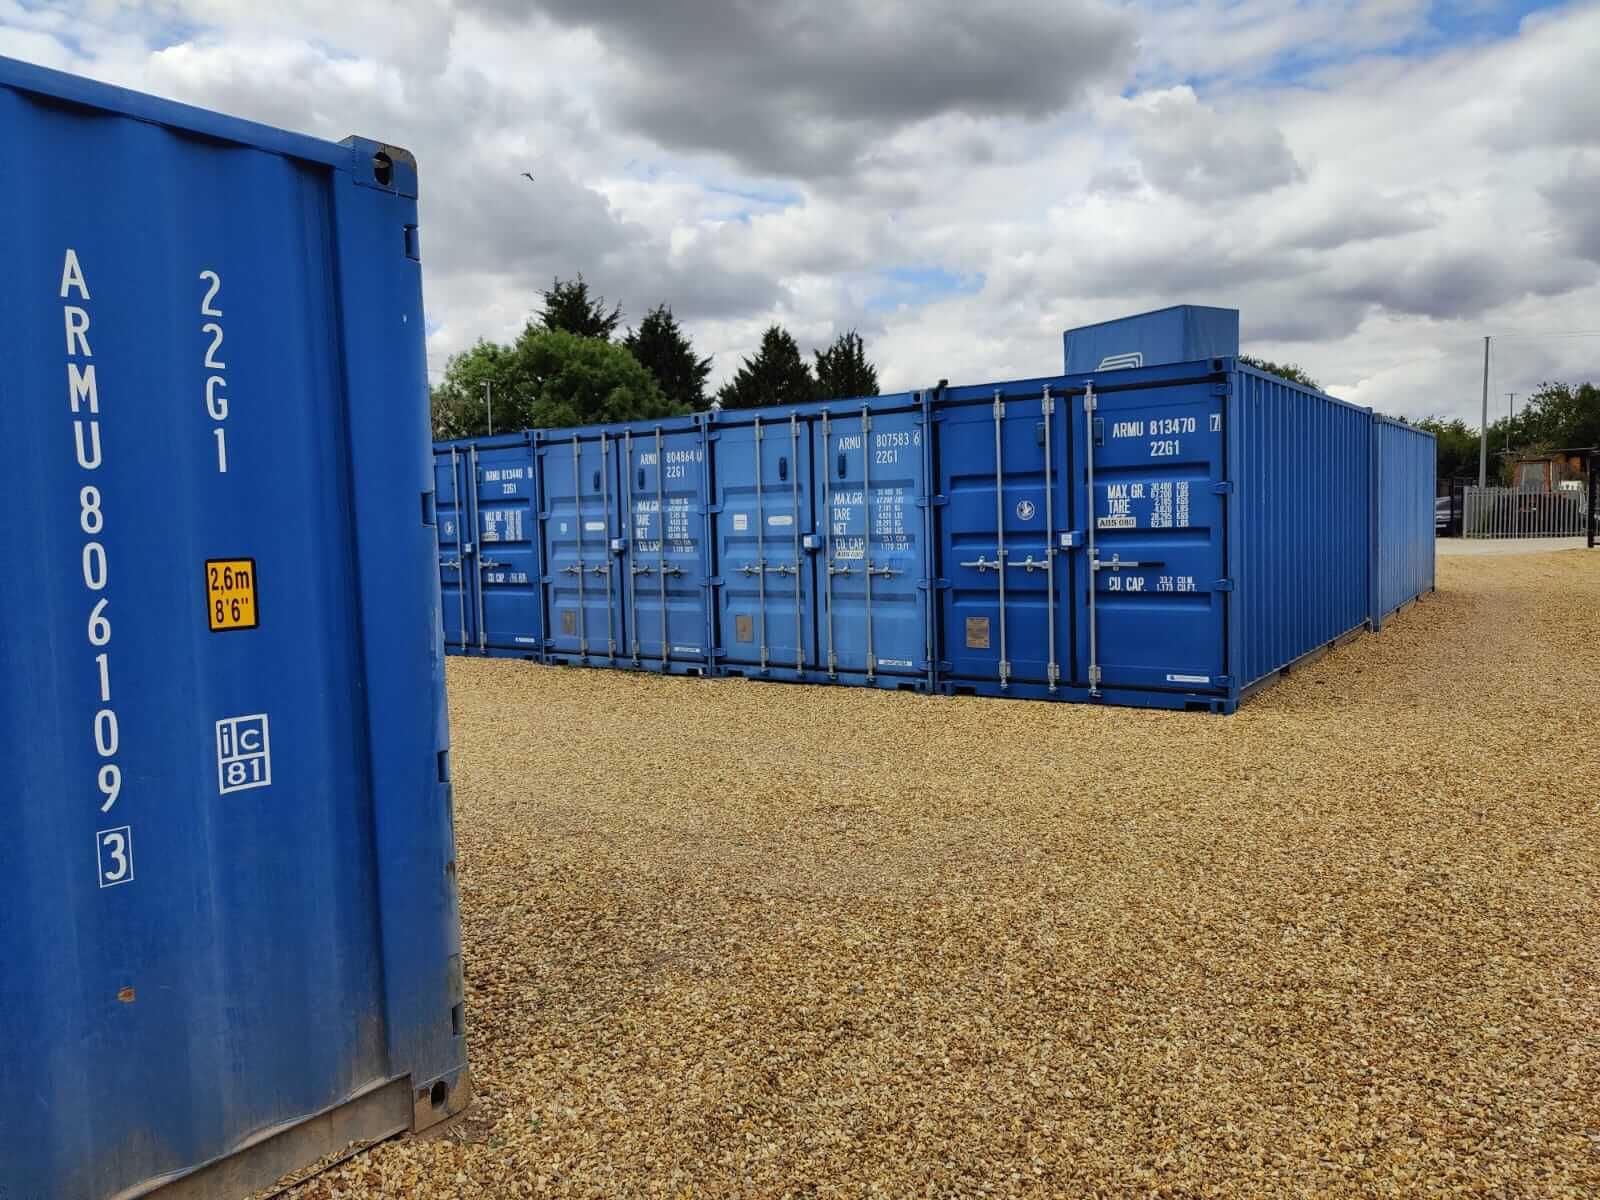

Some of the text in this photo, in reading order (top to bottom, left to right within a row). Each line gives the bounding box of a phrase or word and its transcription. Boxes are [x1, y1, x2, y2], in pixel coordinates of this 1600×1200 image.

[199, 270, 229, 473] 22G1
[1112, 415, 1220, 438] ARMU 813470 7
[839, 437, 861, 450] ARMU
[876, 432, 910, 447] 807583
[1150, 440, 1180, 457] 22G1
[876, 450, 898, 464] 22G1
[666, 466, 685, 478] 22G1
[833, 507, 851, 520] TARE
[1108, 499, 1131, 514] TARE
[833, 522, 848, 535] NET
[60, 248, 127, 880] ARMU 806109 3
[210, 566, 250, 594] 2,6m
[1109, 576, 1125, 591] CU.
[227, 758, 264, 785] 81
